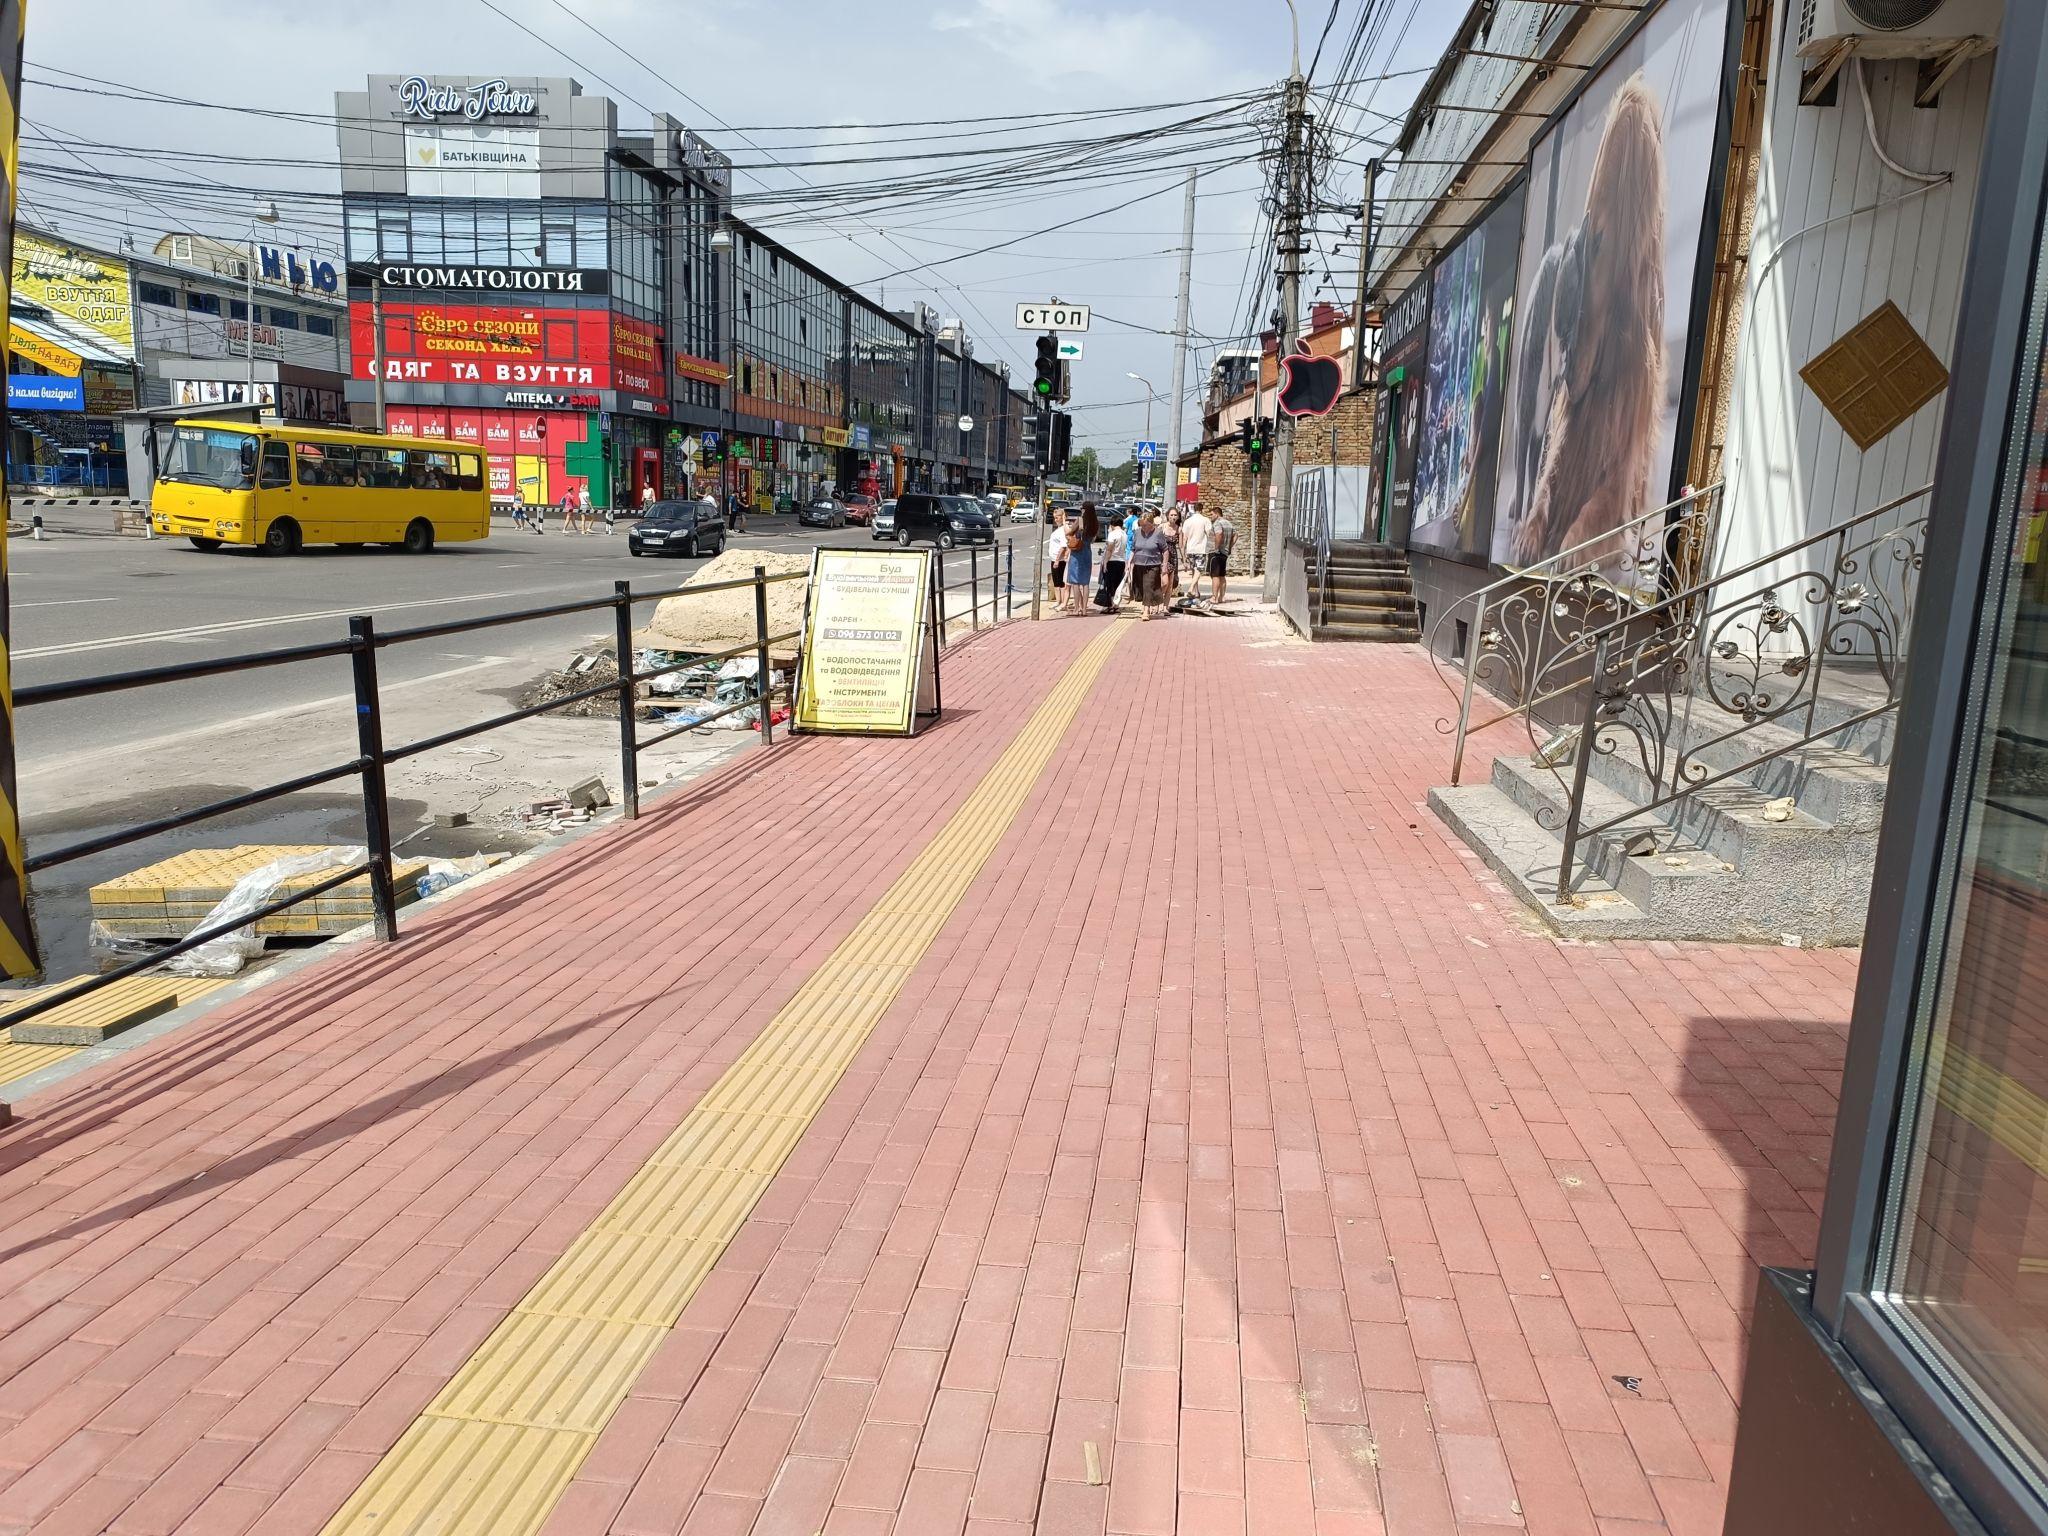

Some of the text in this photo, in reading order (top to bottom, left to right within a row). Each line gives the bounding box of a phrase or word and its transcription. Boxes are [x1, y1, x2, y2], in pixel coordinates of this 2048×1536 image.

[400, 76, 534, 120] Rich Town
[443, 152, 526, 163] БАТЬКІВЩИНА
[258, 245, 338, 292] НЬЮ
[383, 267, 583, 290] СТОМАТОЛОГІЯ
[47, 287, 115, 302] ВЗУТТЯ
[79, 307, 125, 322] ОДЯГ
[1024, 309, 1081, 325] СТОП
[421, 316, 539, 335] ЄВРО СЕЗОНИ
[227, 320, 277, 346] МЕБЛІ
[426, 338, 486, 352] СЕКОНД
[38, 346, 52, 360] НА
[54, 355, 79, 372] ВАГУ
[451, 363, 480, 379] ТА
[496, 364, 592, 384] ВЗУТТЯ
[618, 369, 624, 384] 2
[8, 385, 77, 402] З нами вигідно!
[505, 392, 600, 406] АПТЕКА БАМ
[391, 424, 413, 434] БАМ
[423, 426, 445, 435] БАМ
[455, 427, 477, 437] БАМ
[487, 429, 509, 438] БАМ
[489, 473, 510, 482] БАМ
[880, 564, 902, 574] Буд
[836, 586, 879, 594] БУДІВЕЛЬНІ
[837, 630, 854, 638] 096
[856, 630, 872, 638] 573
[886, 631, 897, 639] 02
[826, 657, 902, 665] ВОДОПОСТАЧАННЯ
[831, 667, 901, 676] ВОДОВІДВЕДЕННЯ
[834, 689, 887, 697] ІНСТРУМЕНТИ
